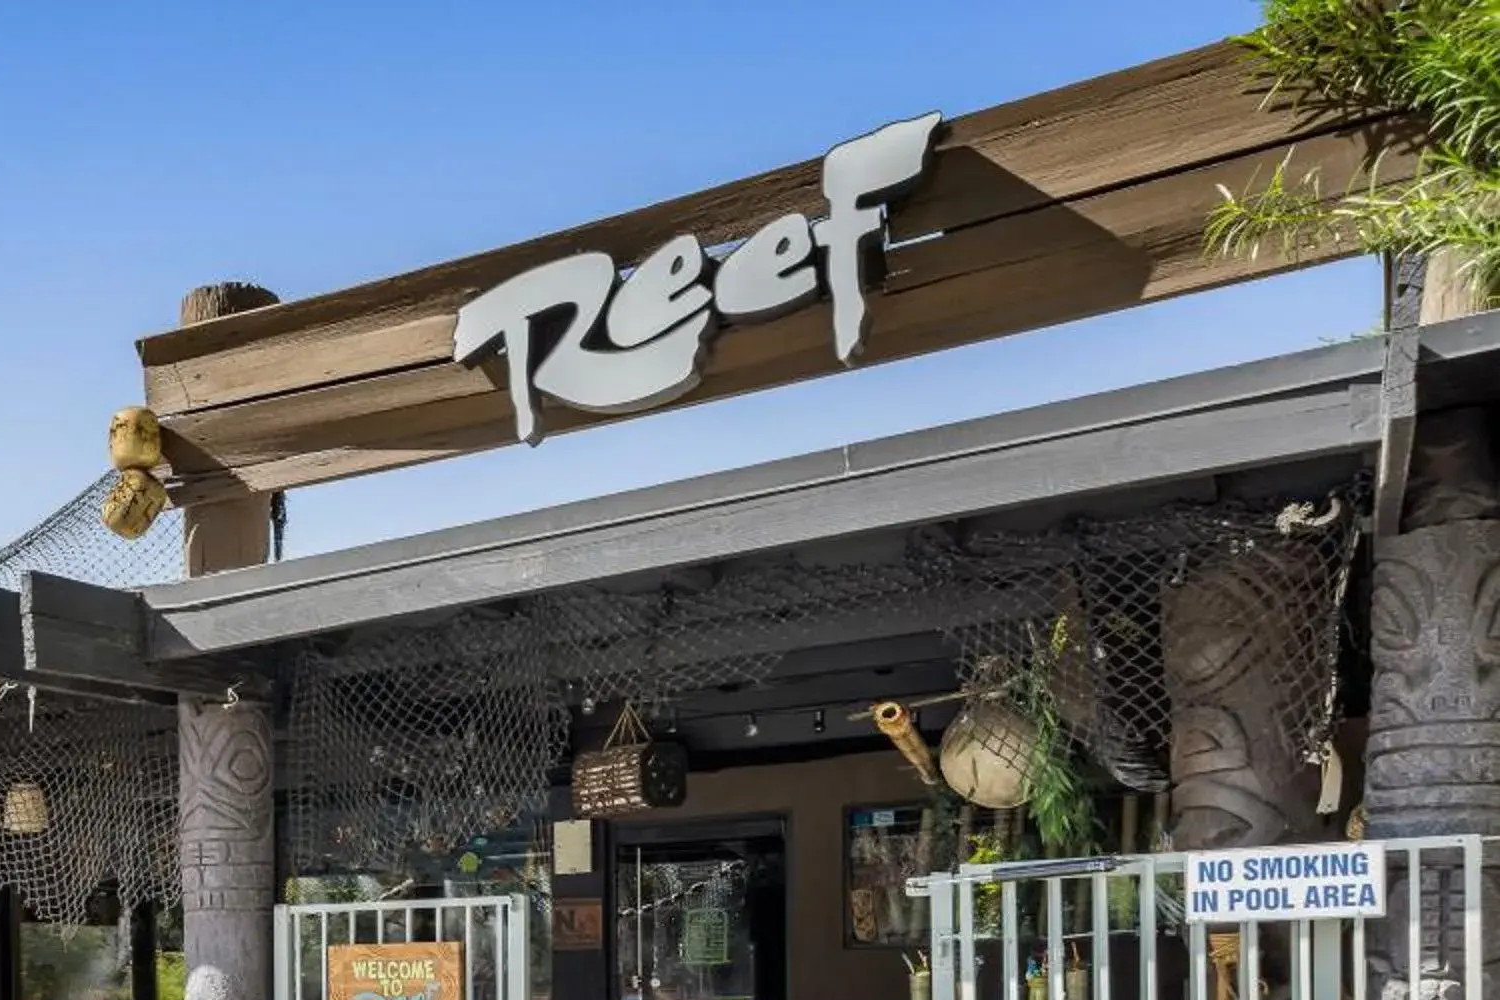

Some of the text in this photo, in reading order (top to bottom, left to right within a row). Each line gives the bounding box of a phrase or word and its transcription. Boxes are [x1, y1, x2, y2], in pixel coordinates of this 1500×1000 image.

[453, 111, 943, 446] Reef
[1198, 852, 1369, 883] NO SMOKING
[1192, 883, 1376, 913] IN POOL AREA
[352, 960, 435, 979] WELCOME
[379, 980, 403, 996] TO
